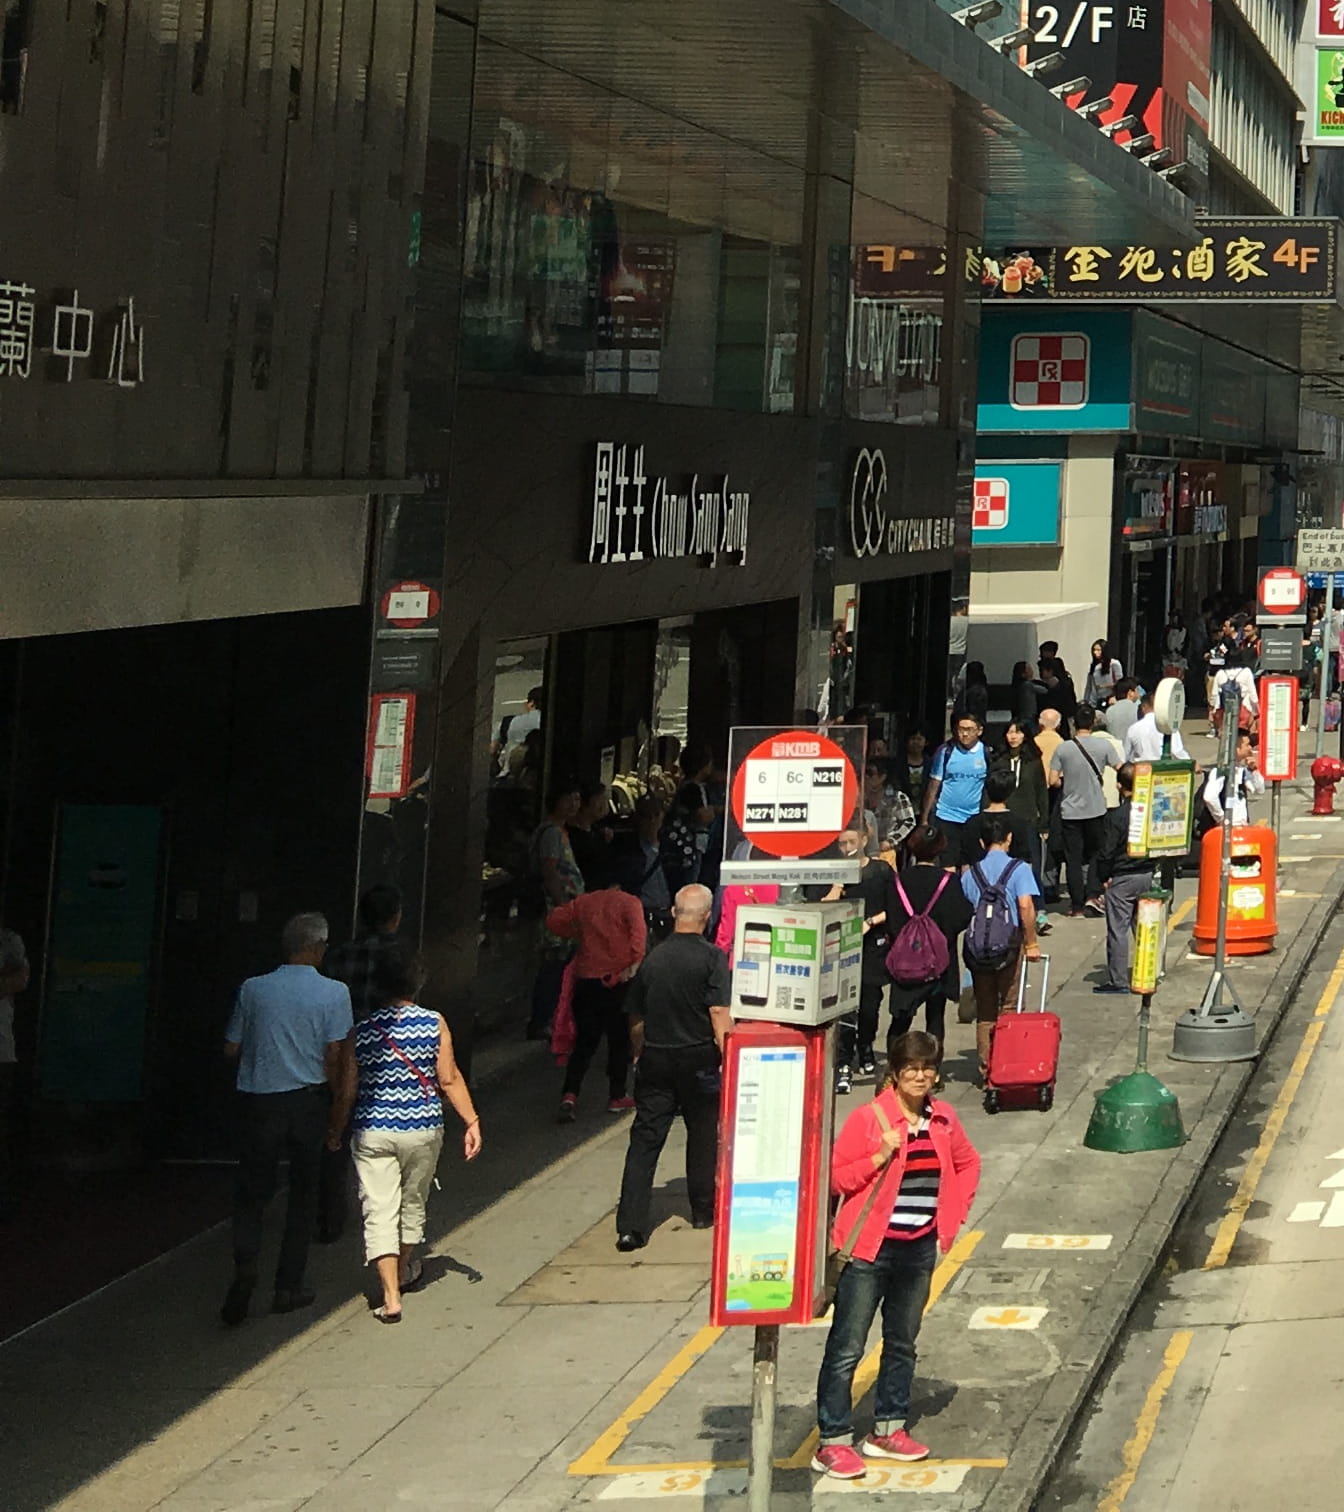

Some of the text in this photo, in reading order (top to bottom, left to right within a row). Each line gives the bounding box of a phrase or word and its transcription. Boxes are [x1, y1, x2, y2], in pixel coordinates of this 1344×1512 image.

[1035, 5, 1113, 44] 2/F
[1064, 236, 1320, 284] 金苑酒家 4F
[784, 741, 820, 757] KMB
[758, 772, 842, 784] 6 6C N216
[746, 806, 808, 820] N271 N281
